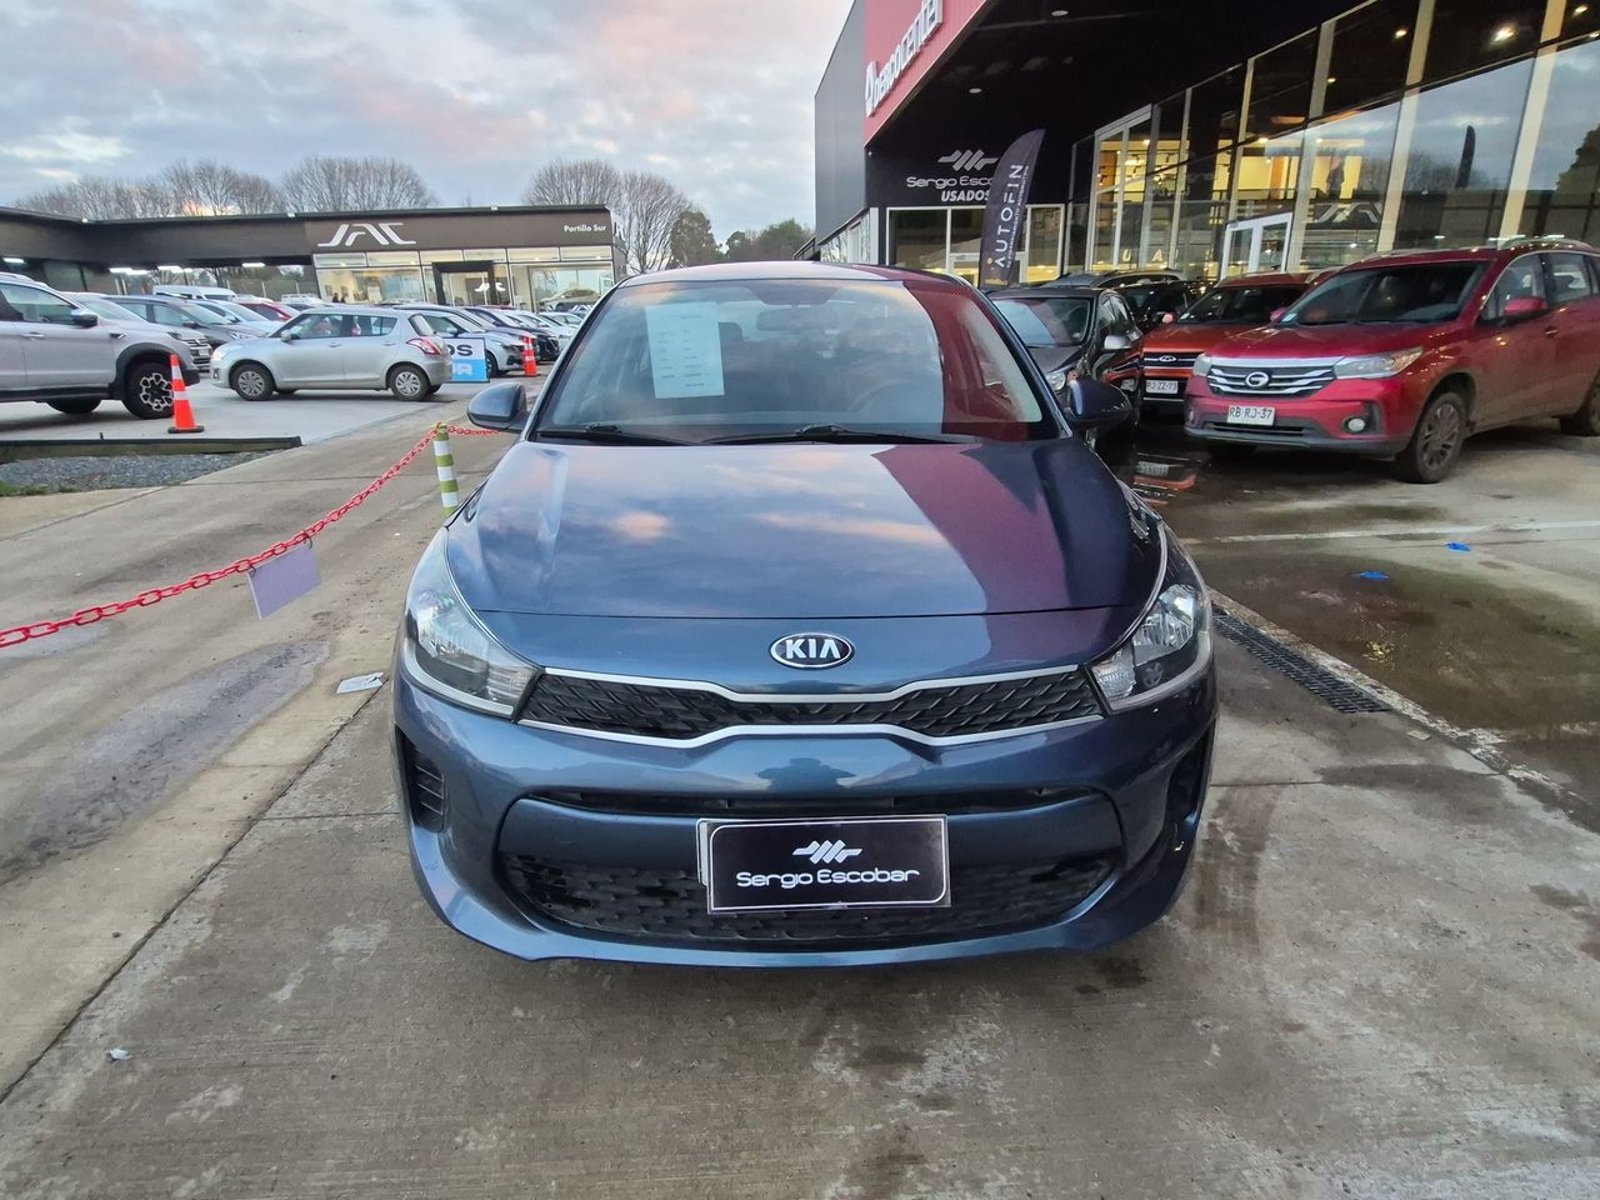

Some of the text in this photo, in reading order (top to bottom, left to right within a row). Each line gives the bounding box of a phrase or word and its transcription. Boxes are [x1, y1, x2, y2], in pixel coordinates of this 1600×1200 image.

[995, 164, 1024, 268] AUTOFIN
[317, 222, 416, 247] JAC
[563, 223, 592, 232] Portillo
[593, 223, 607, 232] Sur
[785, 638, 841, 659] KIA
[736, 867, 920, 889] Sergio Escobar
